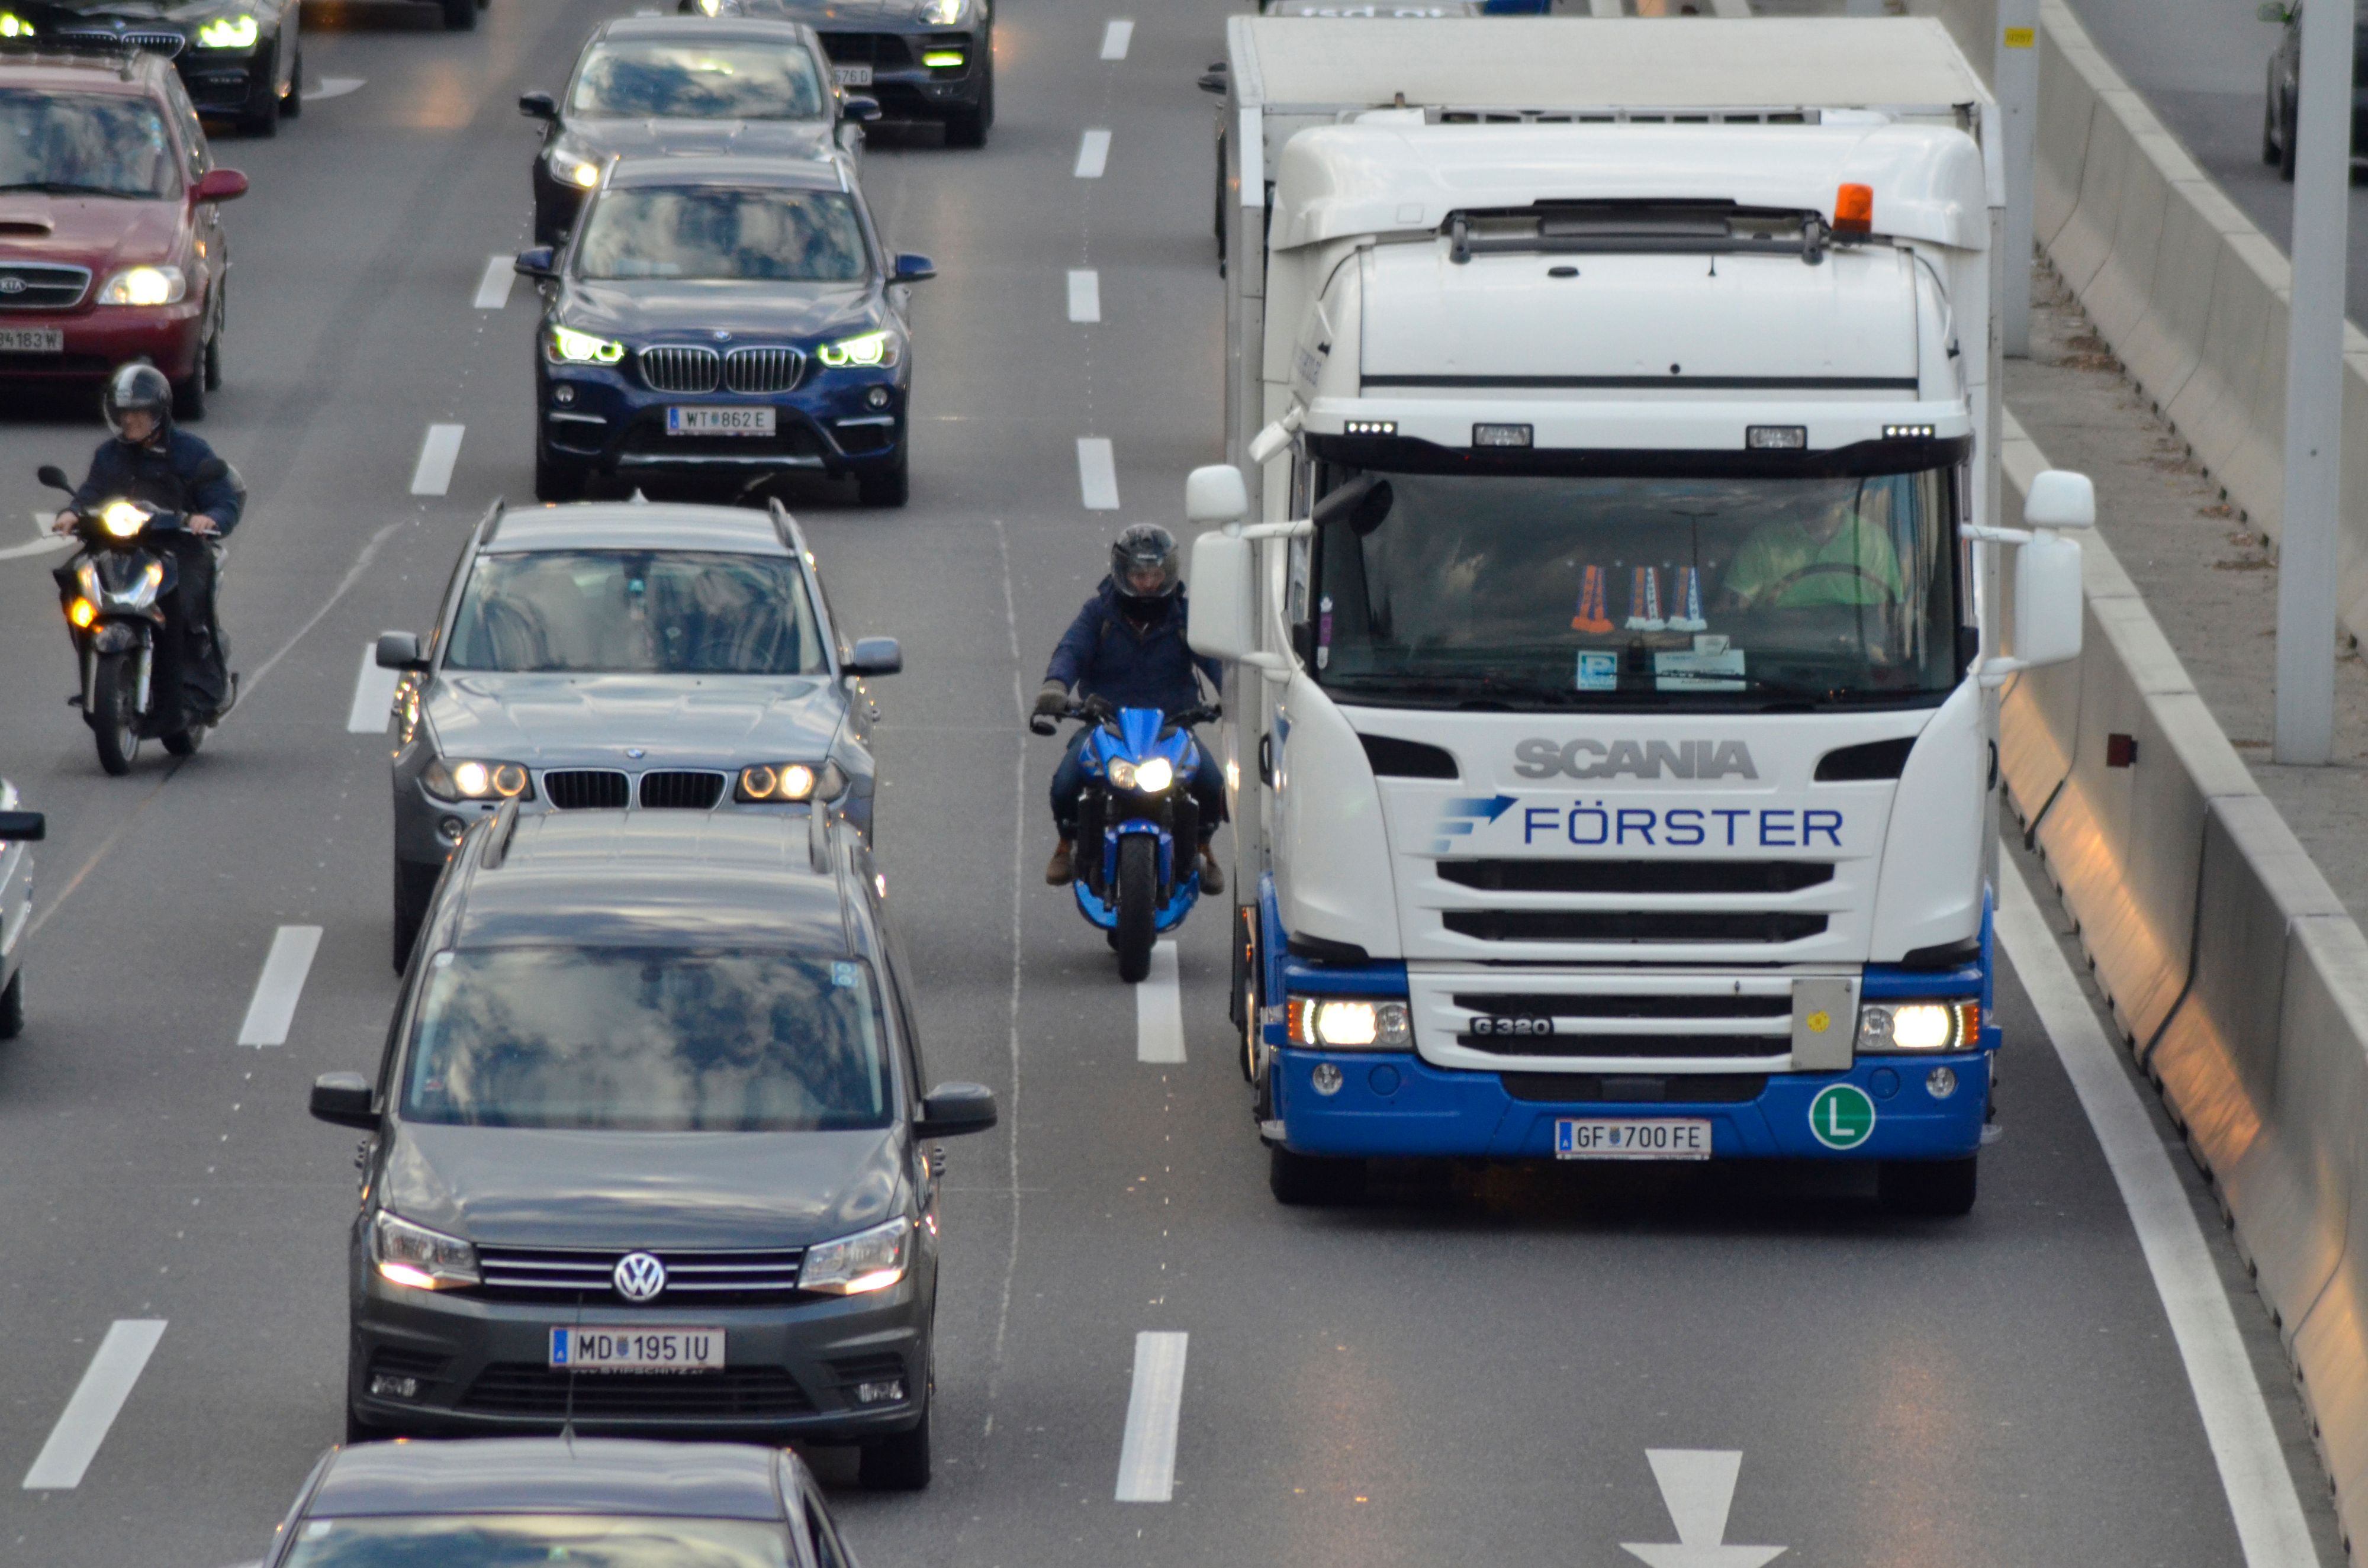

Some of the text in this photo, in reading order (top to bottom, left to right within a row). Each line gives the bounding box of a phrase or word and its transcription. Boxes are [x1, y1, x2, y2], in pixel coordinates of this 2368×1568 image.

[687, 412, 764, 427] WT 862 E
[1514, 738, 1759, 780] SCANIA
[1524, 800, 1843, 846] FÖRSTER
[1475, 1018, 1550, 1035] G 320
[1830, 1096, 1855, 1136] L
[1578, 1126, 1604, 1148] GF
[1625, 1126, 1666, 1148] 700
[1674, 1127, 1700, 1148] FE
[616, 1255, 662, 1298] VW
[580, 1335, 612, 1360] MD
[634, 1336, 676, 1360] 195
[686, 1336, 709, 1360] IU
